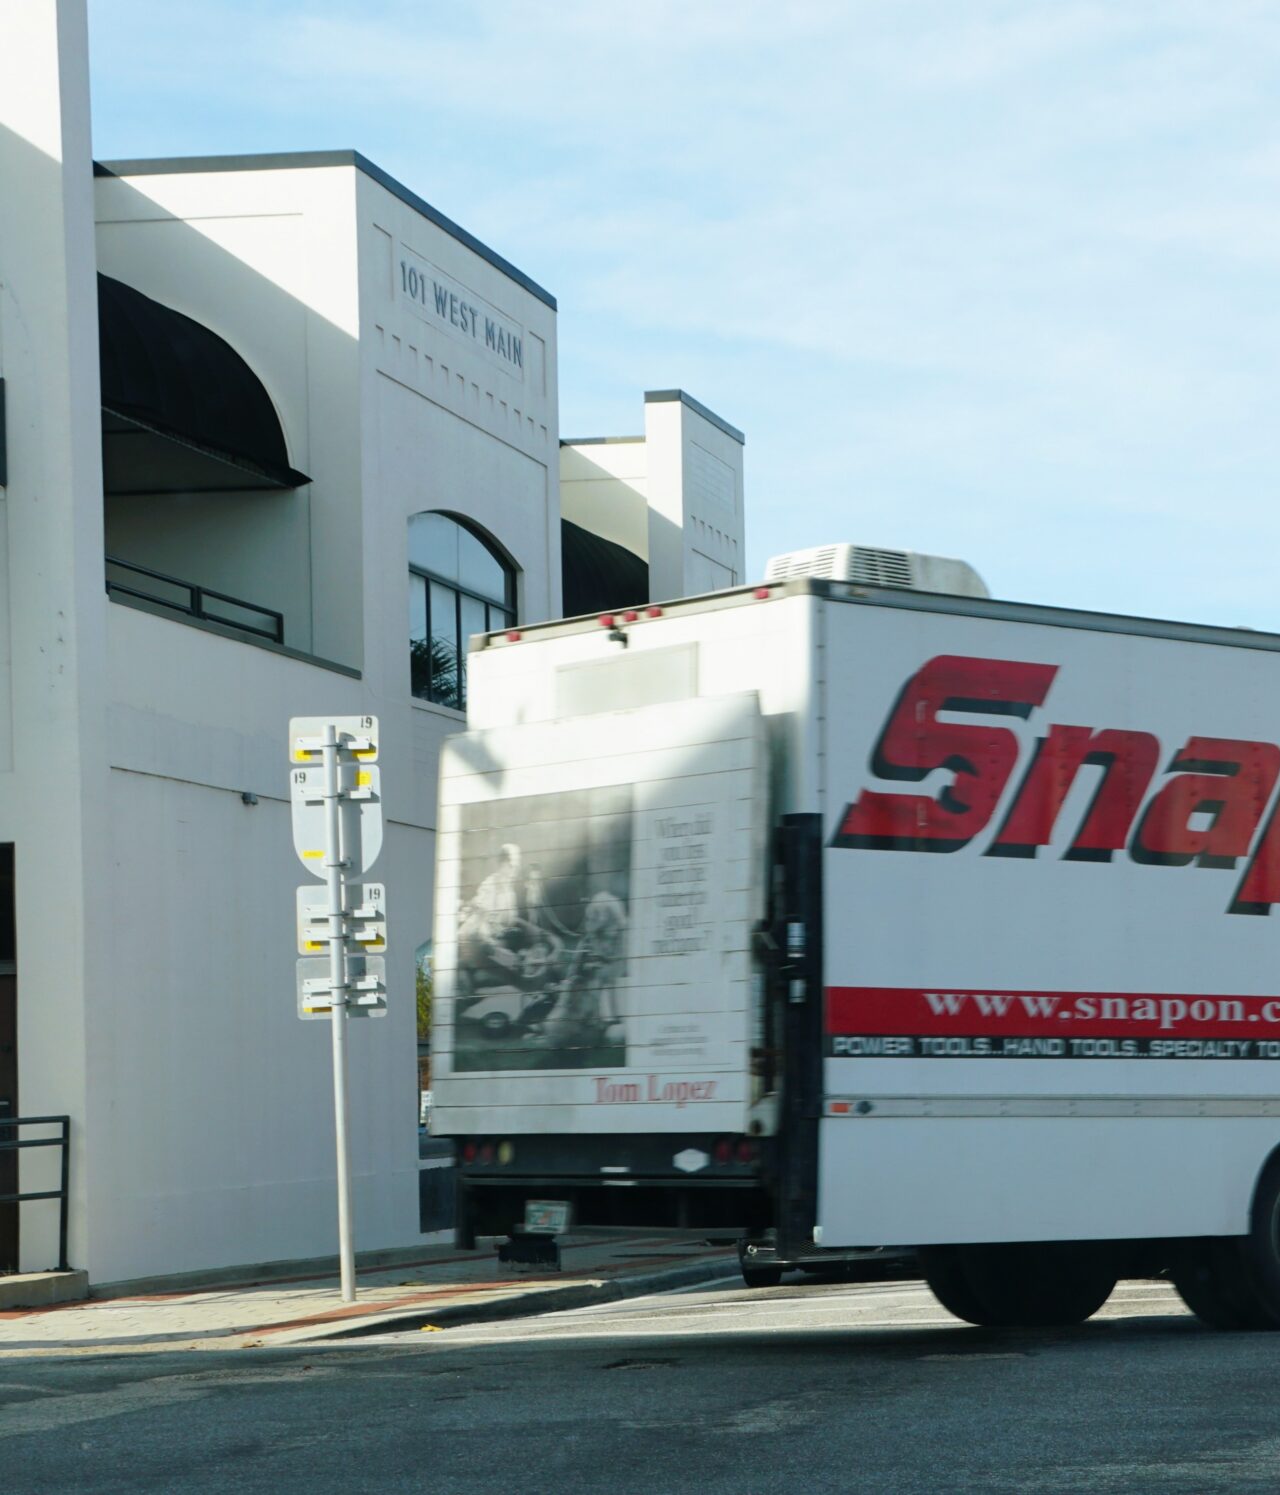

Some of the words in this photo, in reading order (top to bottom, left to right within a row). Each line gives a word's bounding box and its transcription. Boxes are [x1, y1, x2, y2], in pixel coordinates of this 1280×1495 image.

[400, 261, 425, 305] 101
[433, 281, 478, 338] WEST
[485, 316, 522, 368] MAIN
[360, 716, 373, 729] 19
[294, 772, 306, 784] 19
[368, 888, 380, 900] 19
[833, 1037, 914, 1055] POWER
[592, 1076, 641, 1104] Tom
[646, 1073, 718, 1109] Lopez
